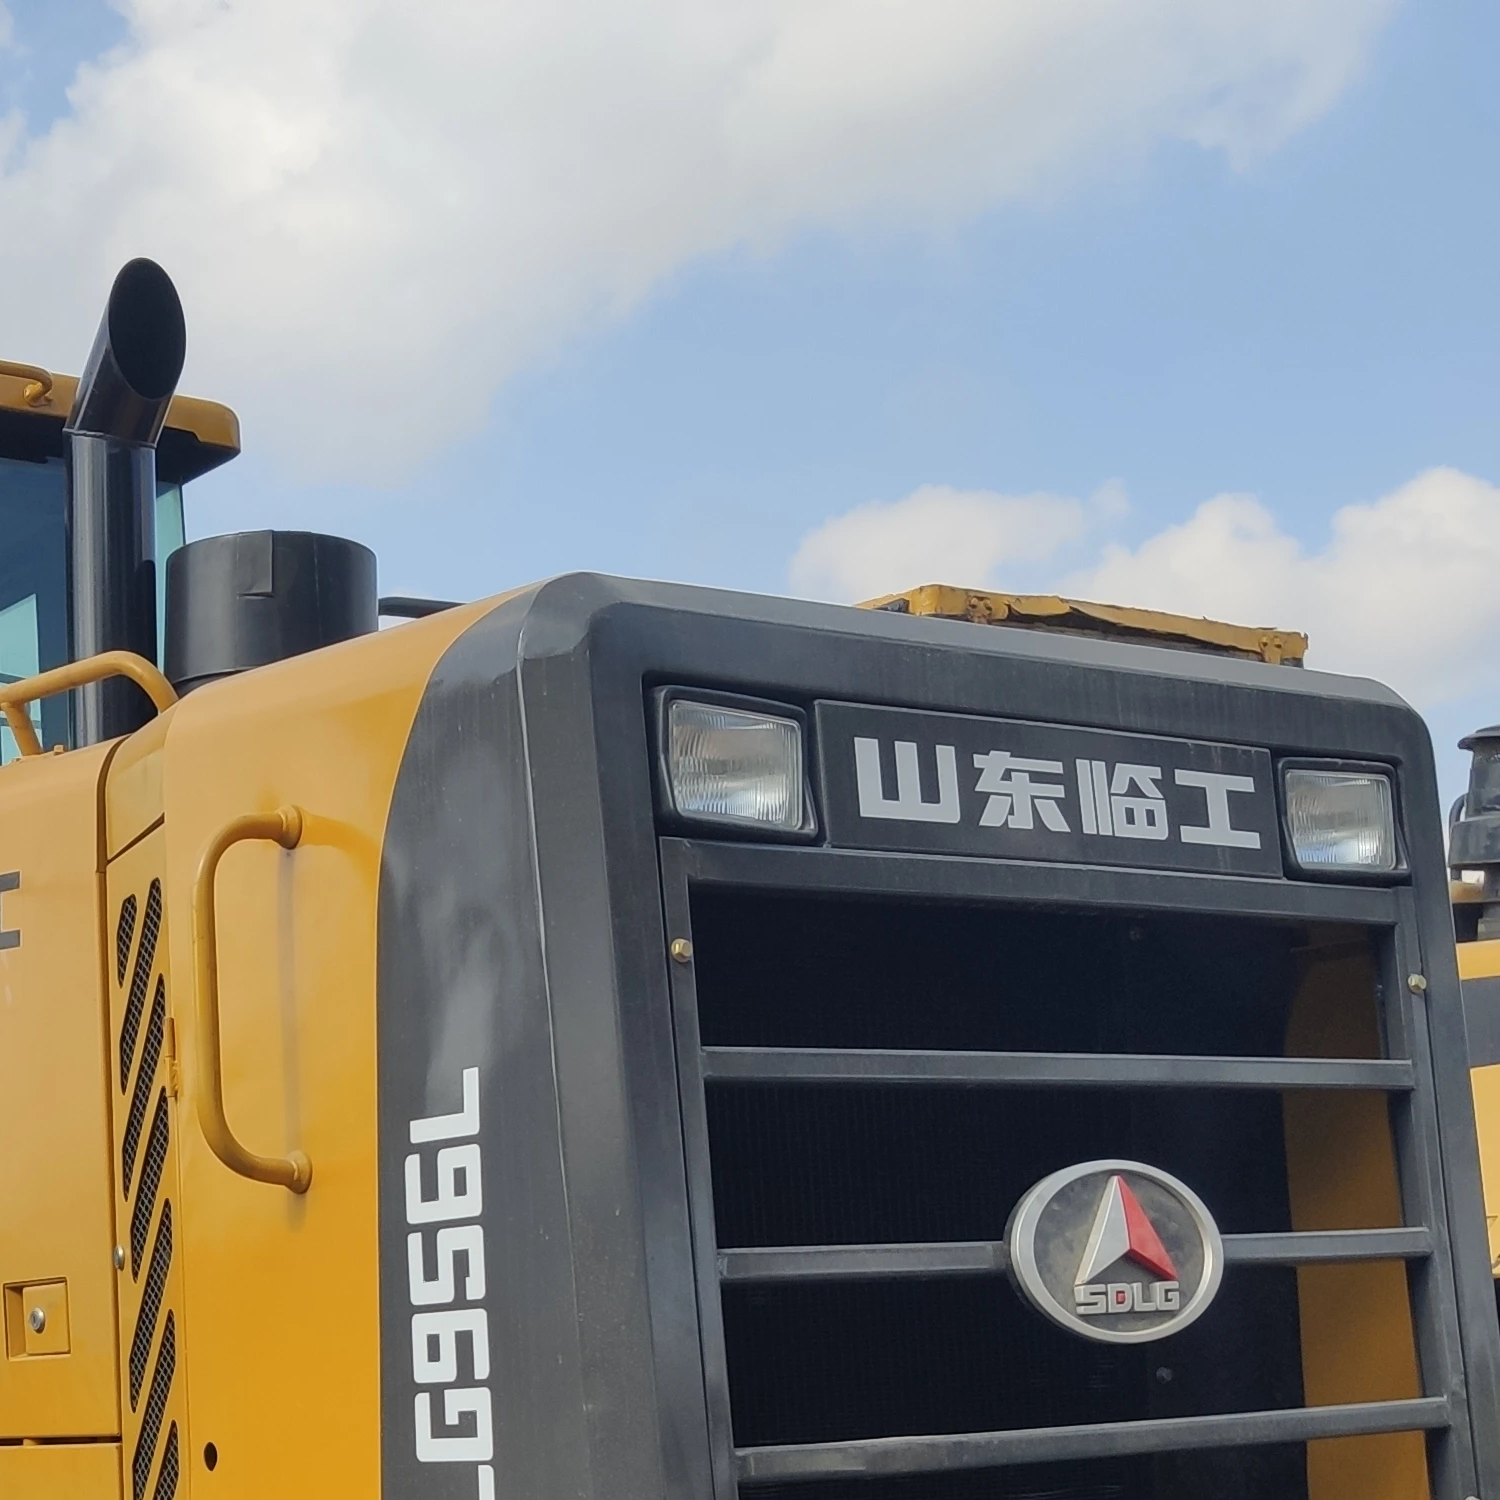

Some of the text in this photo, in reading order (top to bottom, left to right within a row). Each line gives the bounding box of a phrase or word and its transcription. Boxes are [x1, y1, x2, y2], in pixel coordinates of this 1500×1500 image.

[854, 737, 1261, 849] 山东临工
[1074, 1281, 1180, 1315] SDLG
